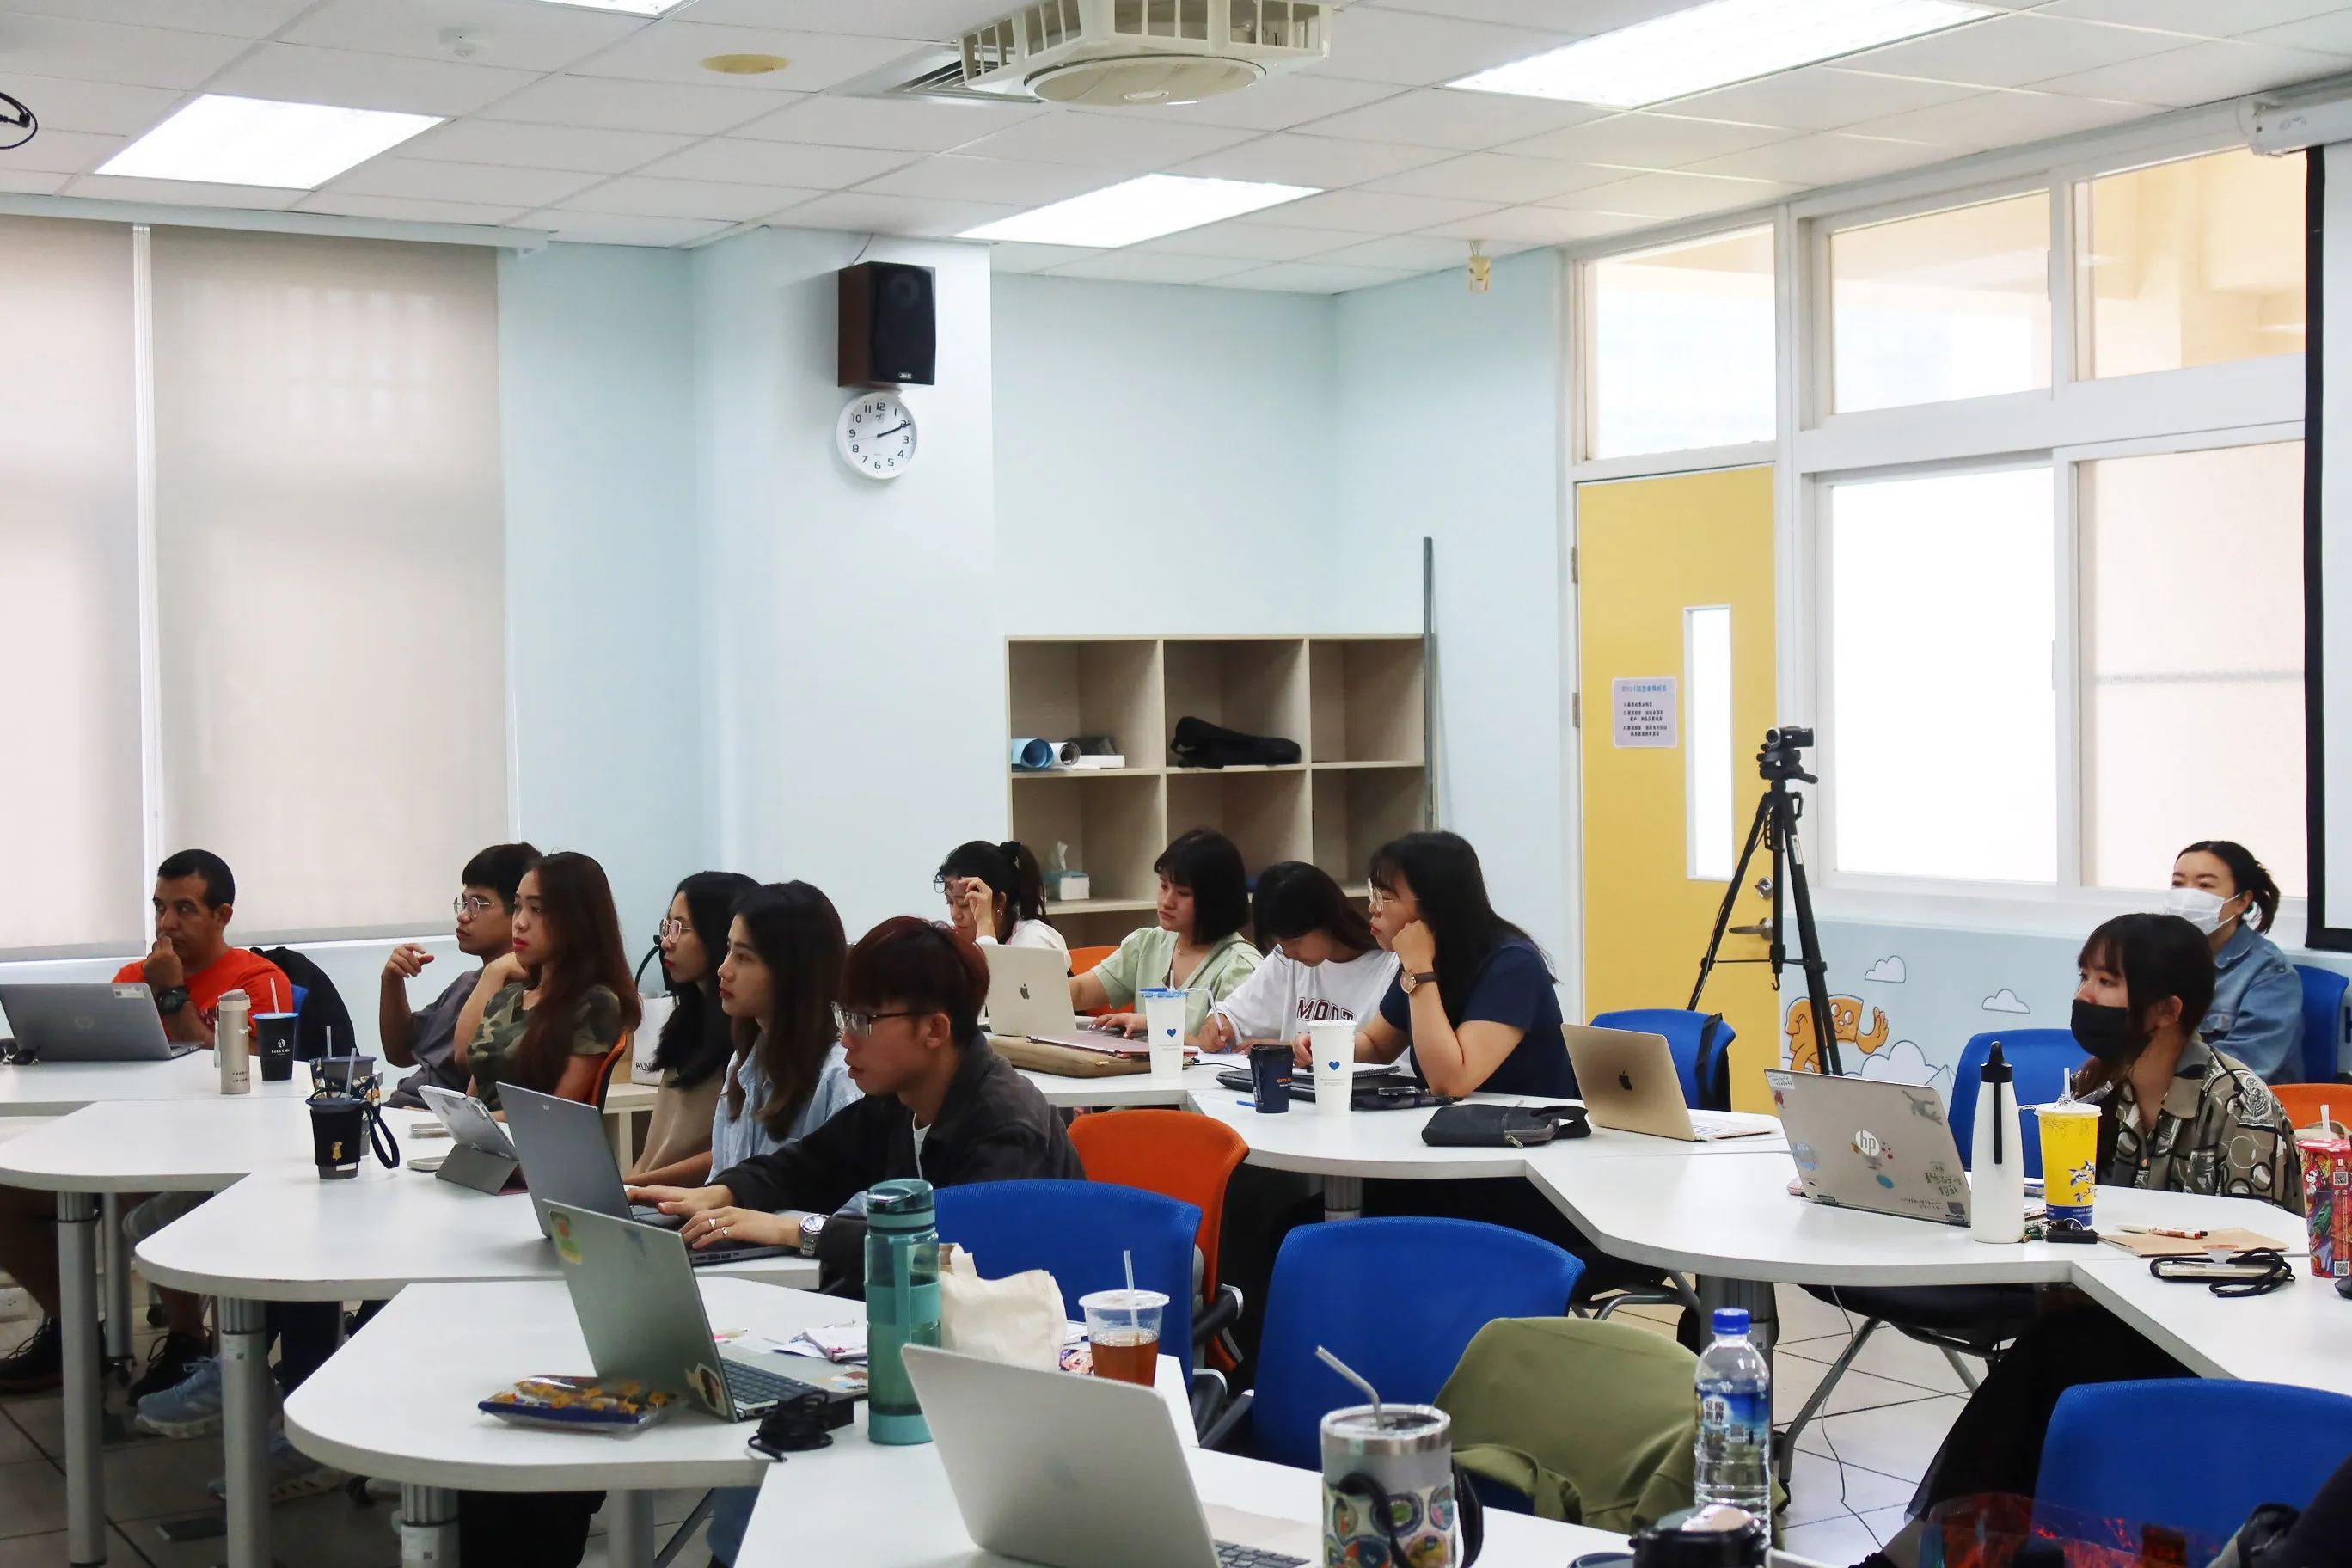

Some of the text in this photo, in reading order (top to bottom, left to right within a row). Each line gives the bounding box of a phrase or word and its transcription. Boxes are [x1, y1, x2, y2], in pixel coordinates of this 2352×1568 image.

[865, 404, 872, 413] 11
[877, 402, 886, 411] 12
[894, 407, 897, 417] 1
[853, 414, 862, 423] 10
[849, 429, 856, 438] 9
[903, 436, 910, 444] 3
[852, 444, 860, 453] 8
[897, 450, 904, 458] 4
[861, 455, 868, 463] 7
[887, 458, 894, 467] 5
[874, 461, 881, 469] 6
[1859, 1130, 1877, 1156] hp
